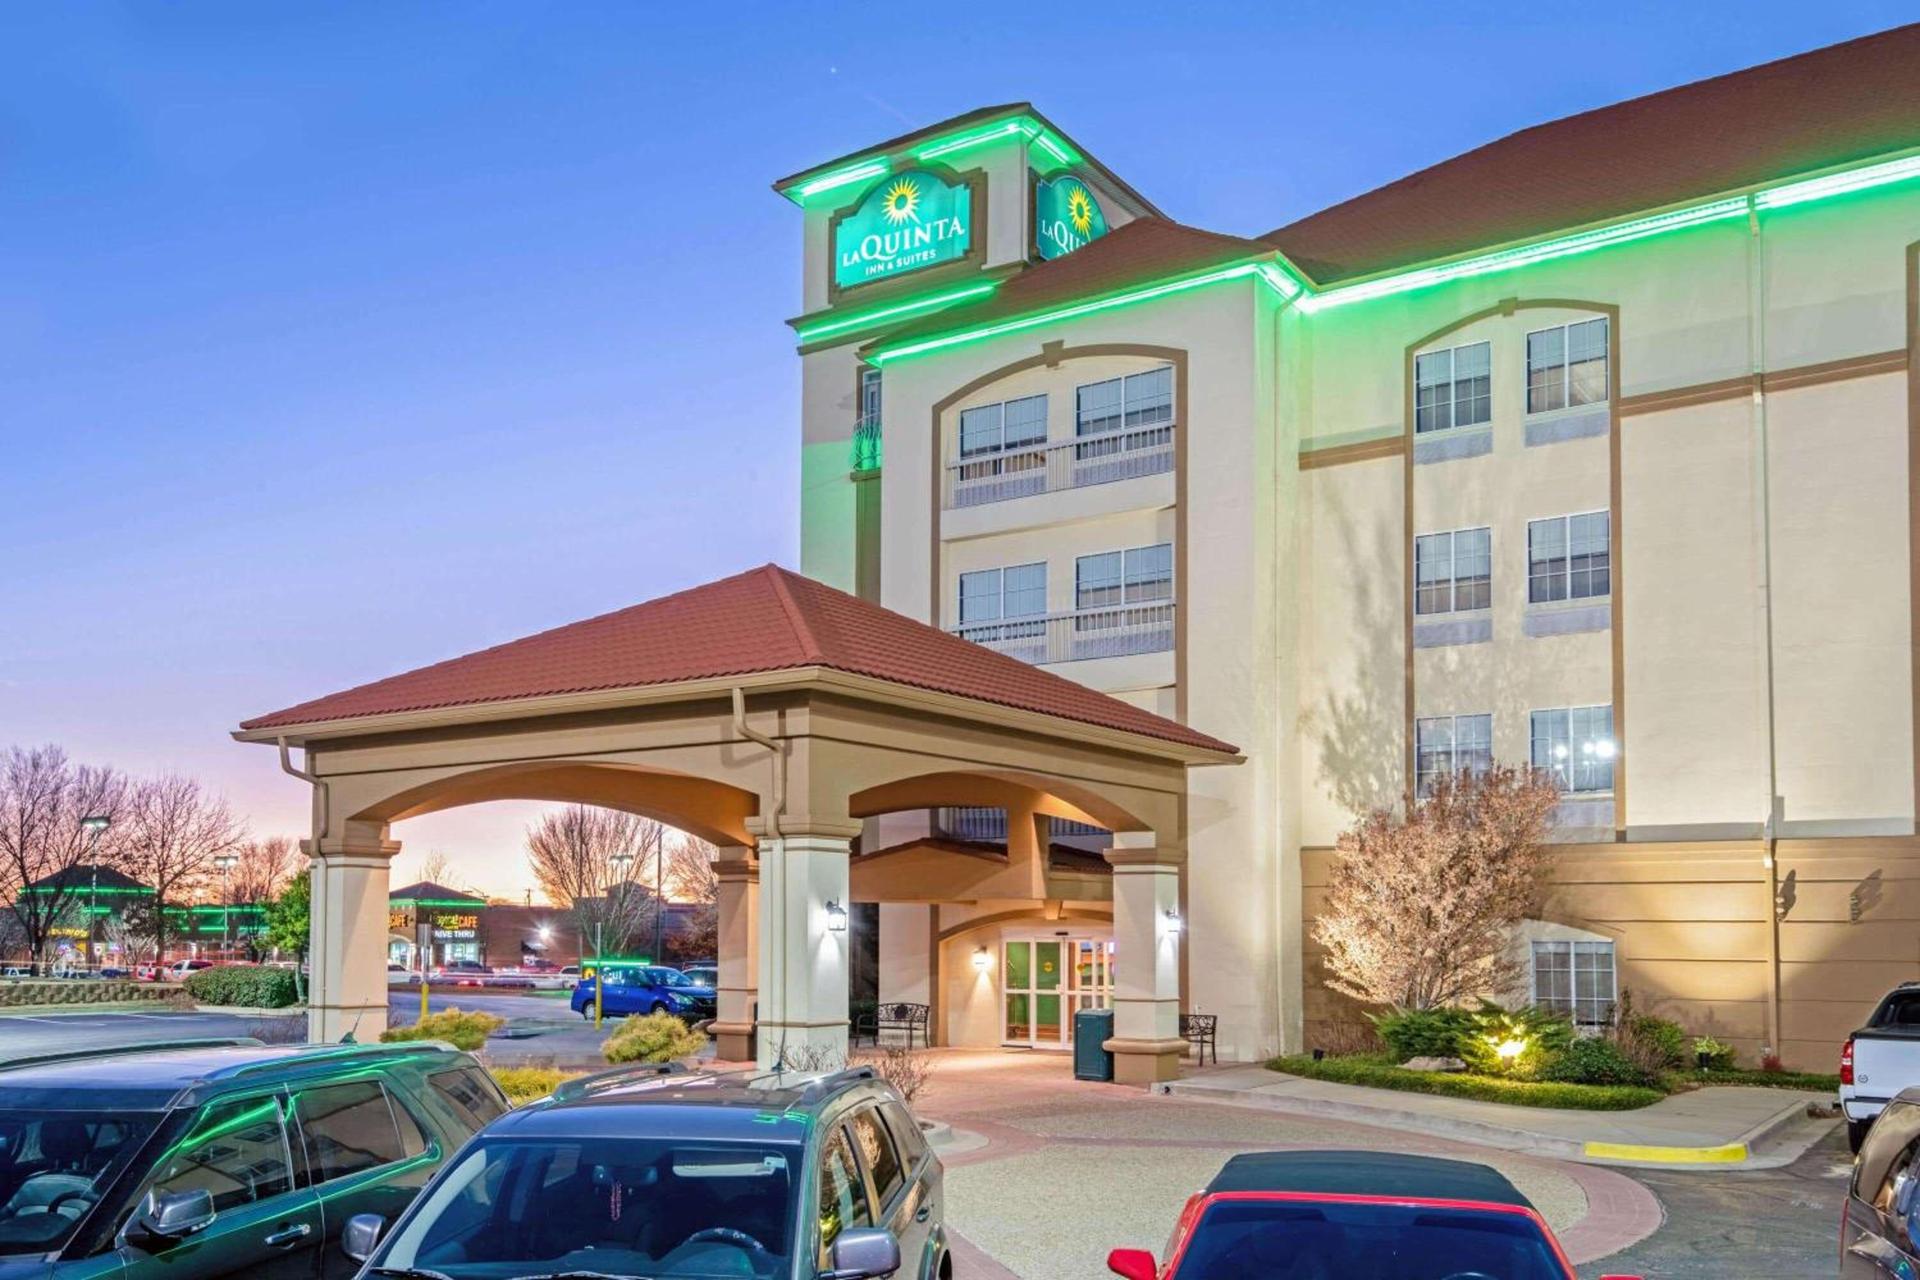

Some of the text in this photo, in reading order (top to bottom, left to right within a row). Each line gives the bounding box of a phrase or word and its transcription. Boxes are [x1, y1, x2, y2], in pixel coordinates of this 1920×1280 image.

[1042, 219, 1054, 240] LA
[843, 216, 966, 267] LA QUINTA
[865, 249, 937, 276] INN & SUITES
[459, 915, 478, 928] CAFE
[455, 930, 475, 938] THRU
